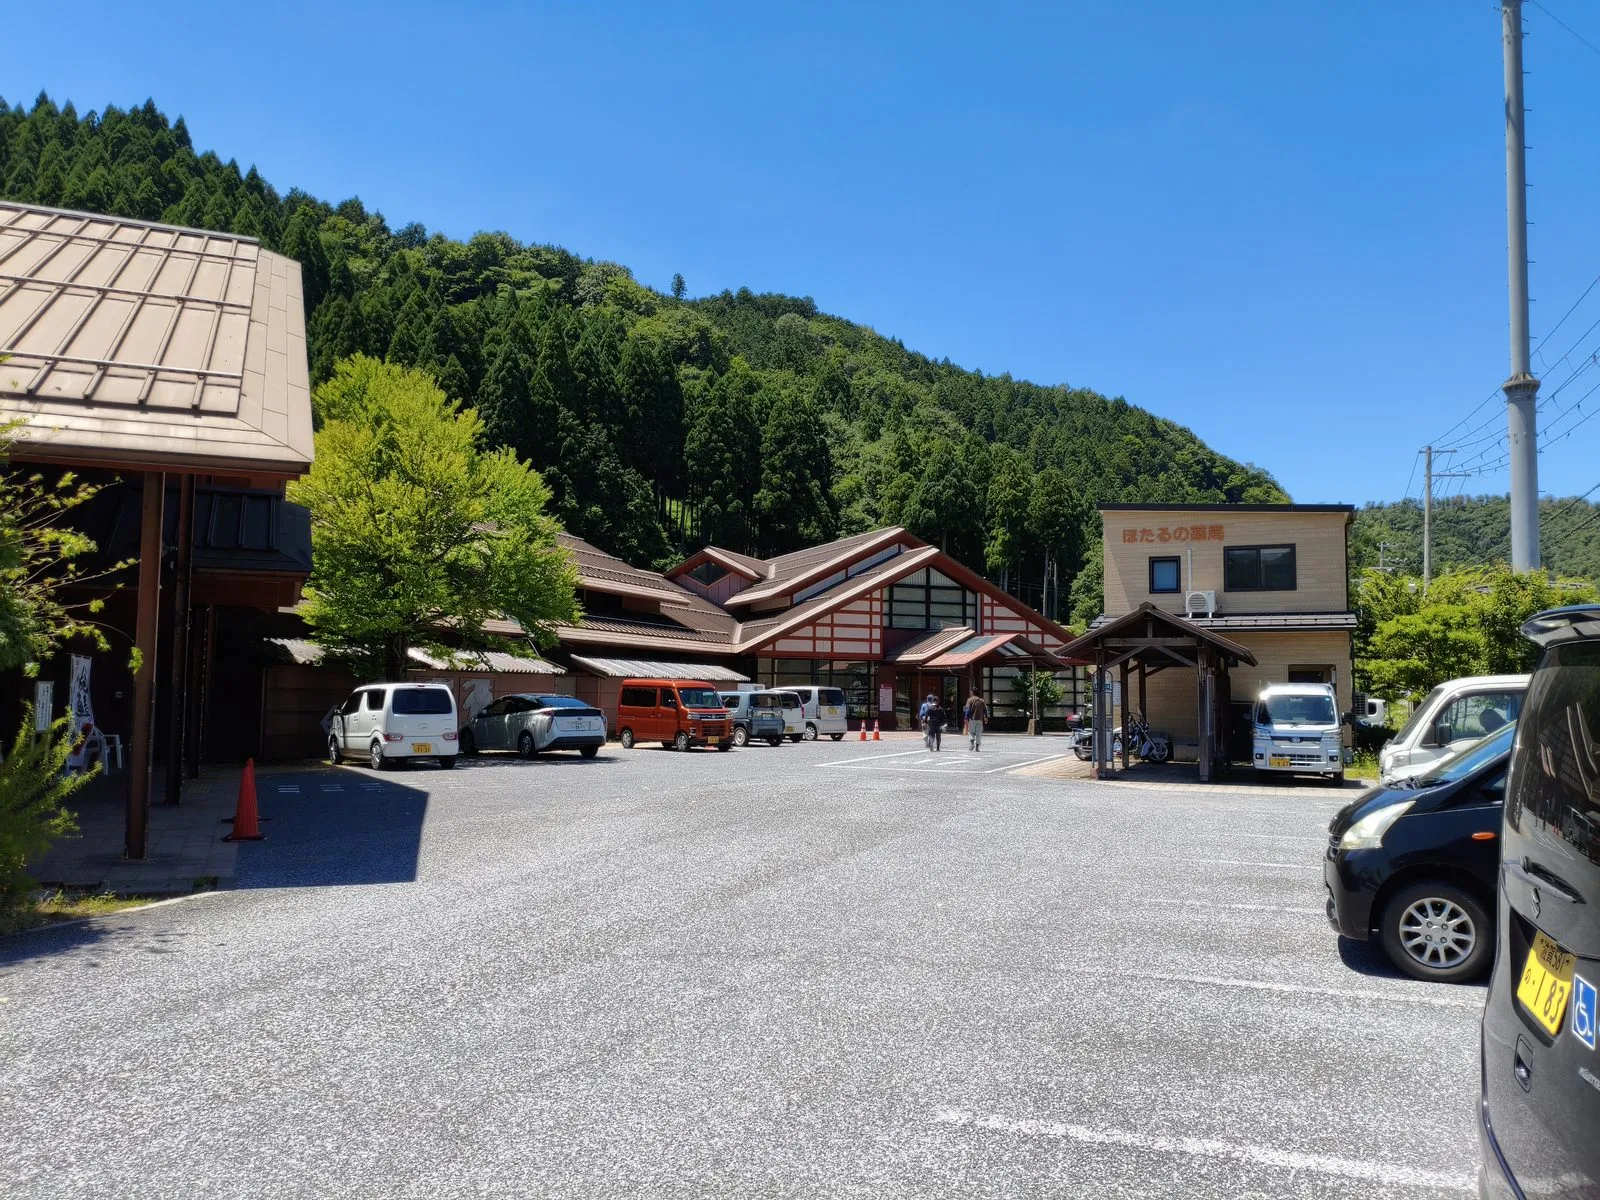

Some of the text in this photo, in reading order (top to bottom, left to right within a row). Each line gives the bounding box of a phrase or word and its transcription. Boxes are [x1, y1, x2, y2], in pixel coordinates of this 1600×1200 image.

[1122, 524, 1225, 544] ほたるの薬局
